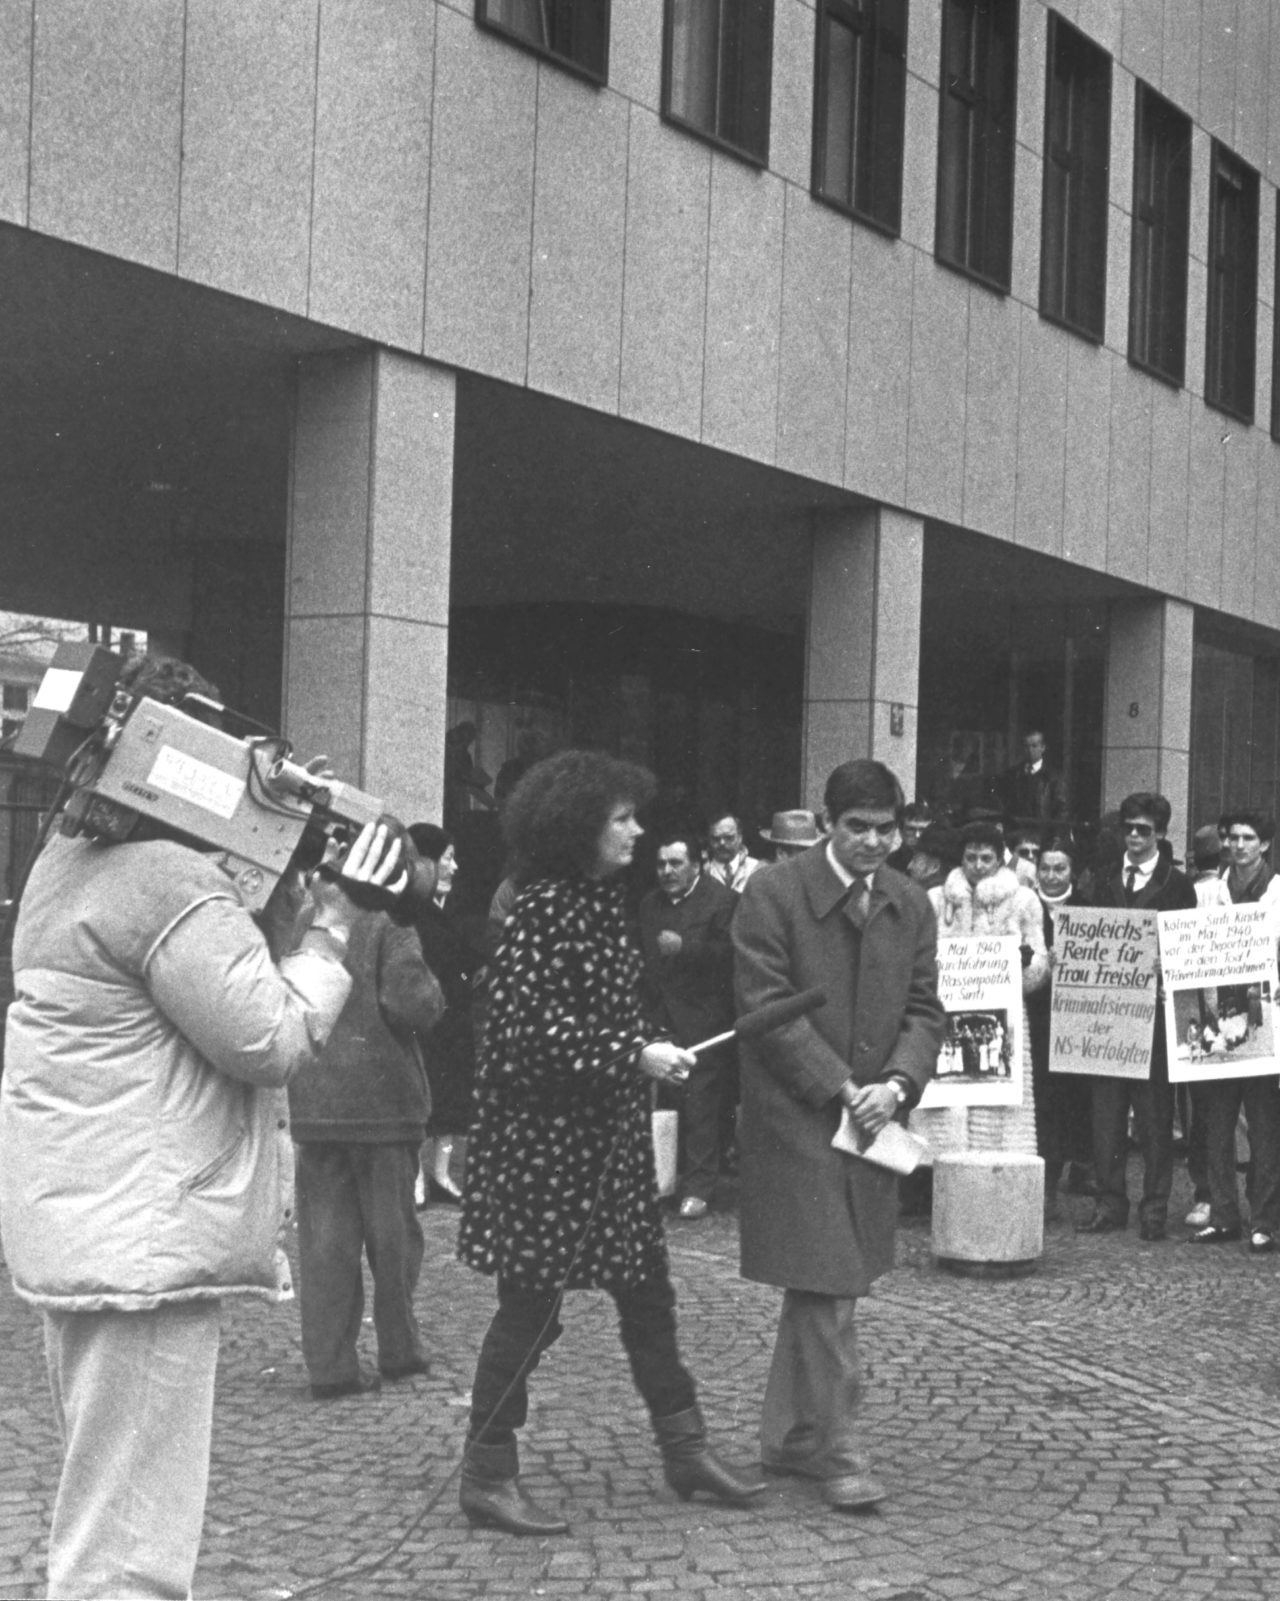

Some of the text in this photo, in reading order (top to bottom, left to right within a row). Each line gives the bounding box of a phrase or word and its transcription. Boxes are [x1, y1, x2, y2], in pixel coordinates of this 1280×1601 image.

[1207, 912, 1229, 925] Sinti
[1235, 910, 1265, 921] Kinder
[1180, 925, 1251, 941] im Mai 1940
[976, 942, 1001, 954] 1940
[1063, 940, 1143, 962] Rente für
[1165, 936, 1269, 956] vor der Deportation
[1197, 955, 1217, 965] den
[1056, 963, 1154, 988] Frau Freisler
[960, 987, 984, 1000] Sinti
[1052, 990, 1155, 1023] Kriminalisierung
[1087, 1021, 1113, 1034] der
[1055, 1035, 1150, 1065] NS-Verfolgten
